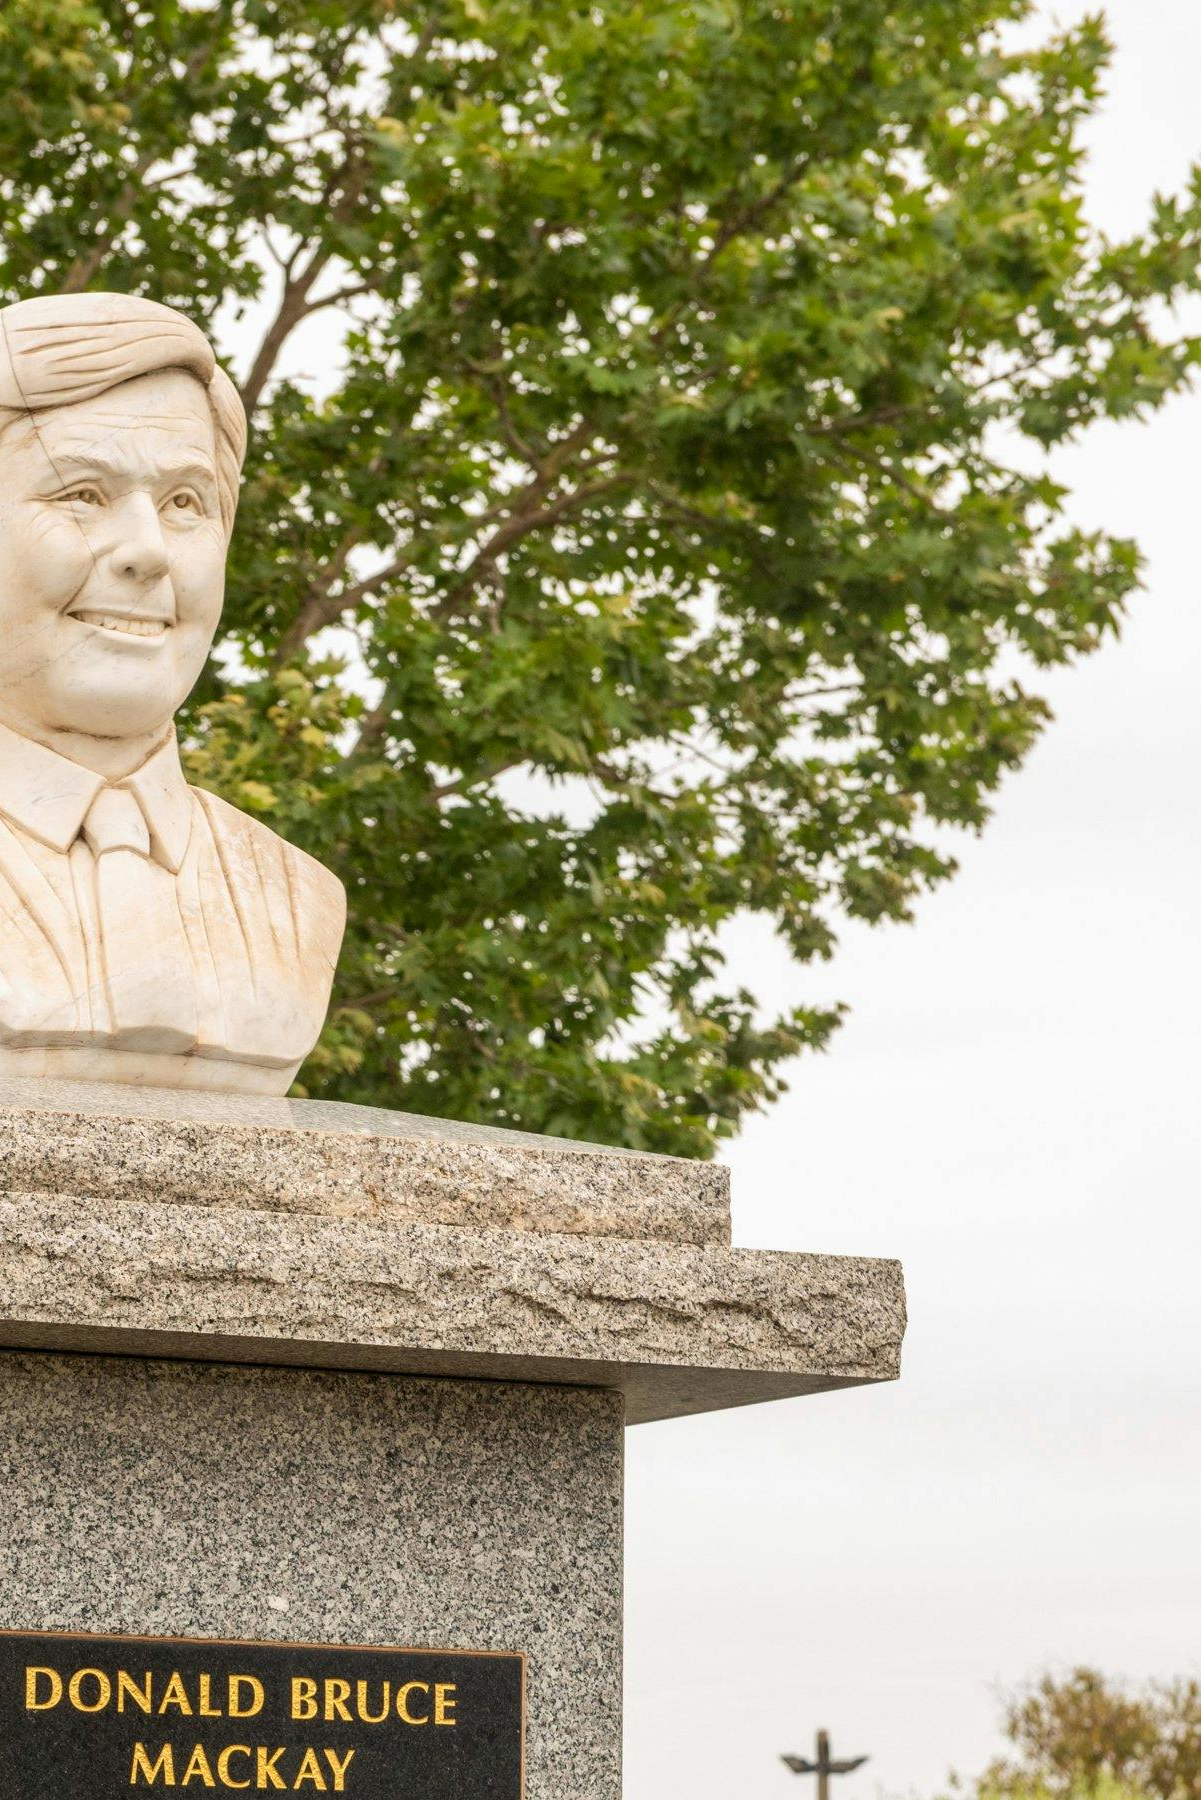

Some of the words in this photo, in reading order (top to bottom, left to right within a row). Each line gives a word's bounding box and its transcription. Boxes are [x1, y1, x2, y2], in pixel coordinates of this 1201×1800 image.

[25, 1666, 265, 1718] DONALD
[291, 1677, 457, 1726] BRUCE
[130, 1742, 355, 1792] MACKAY
